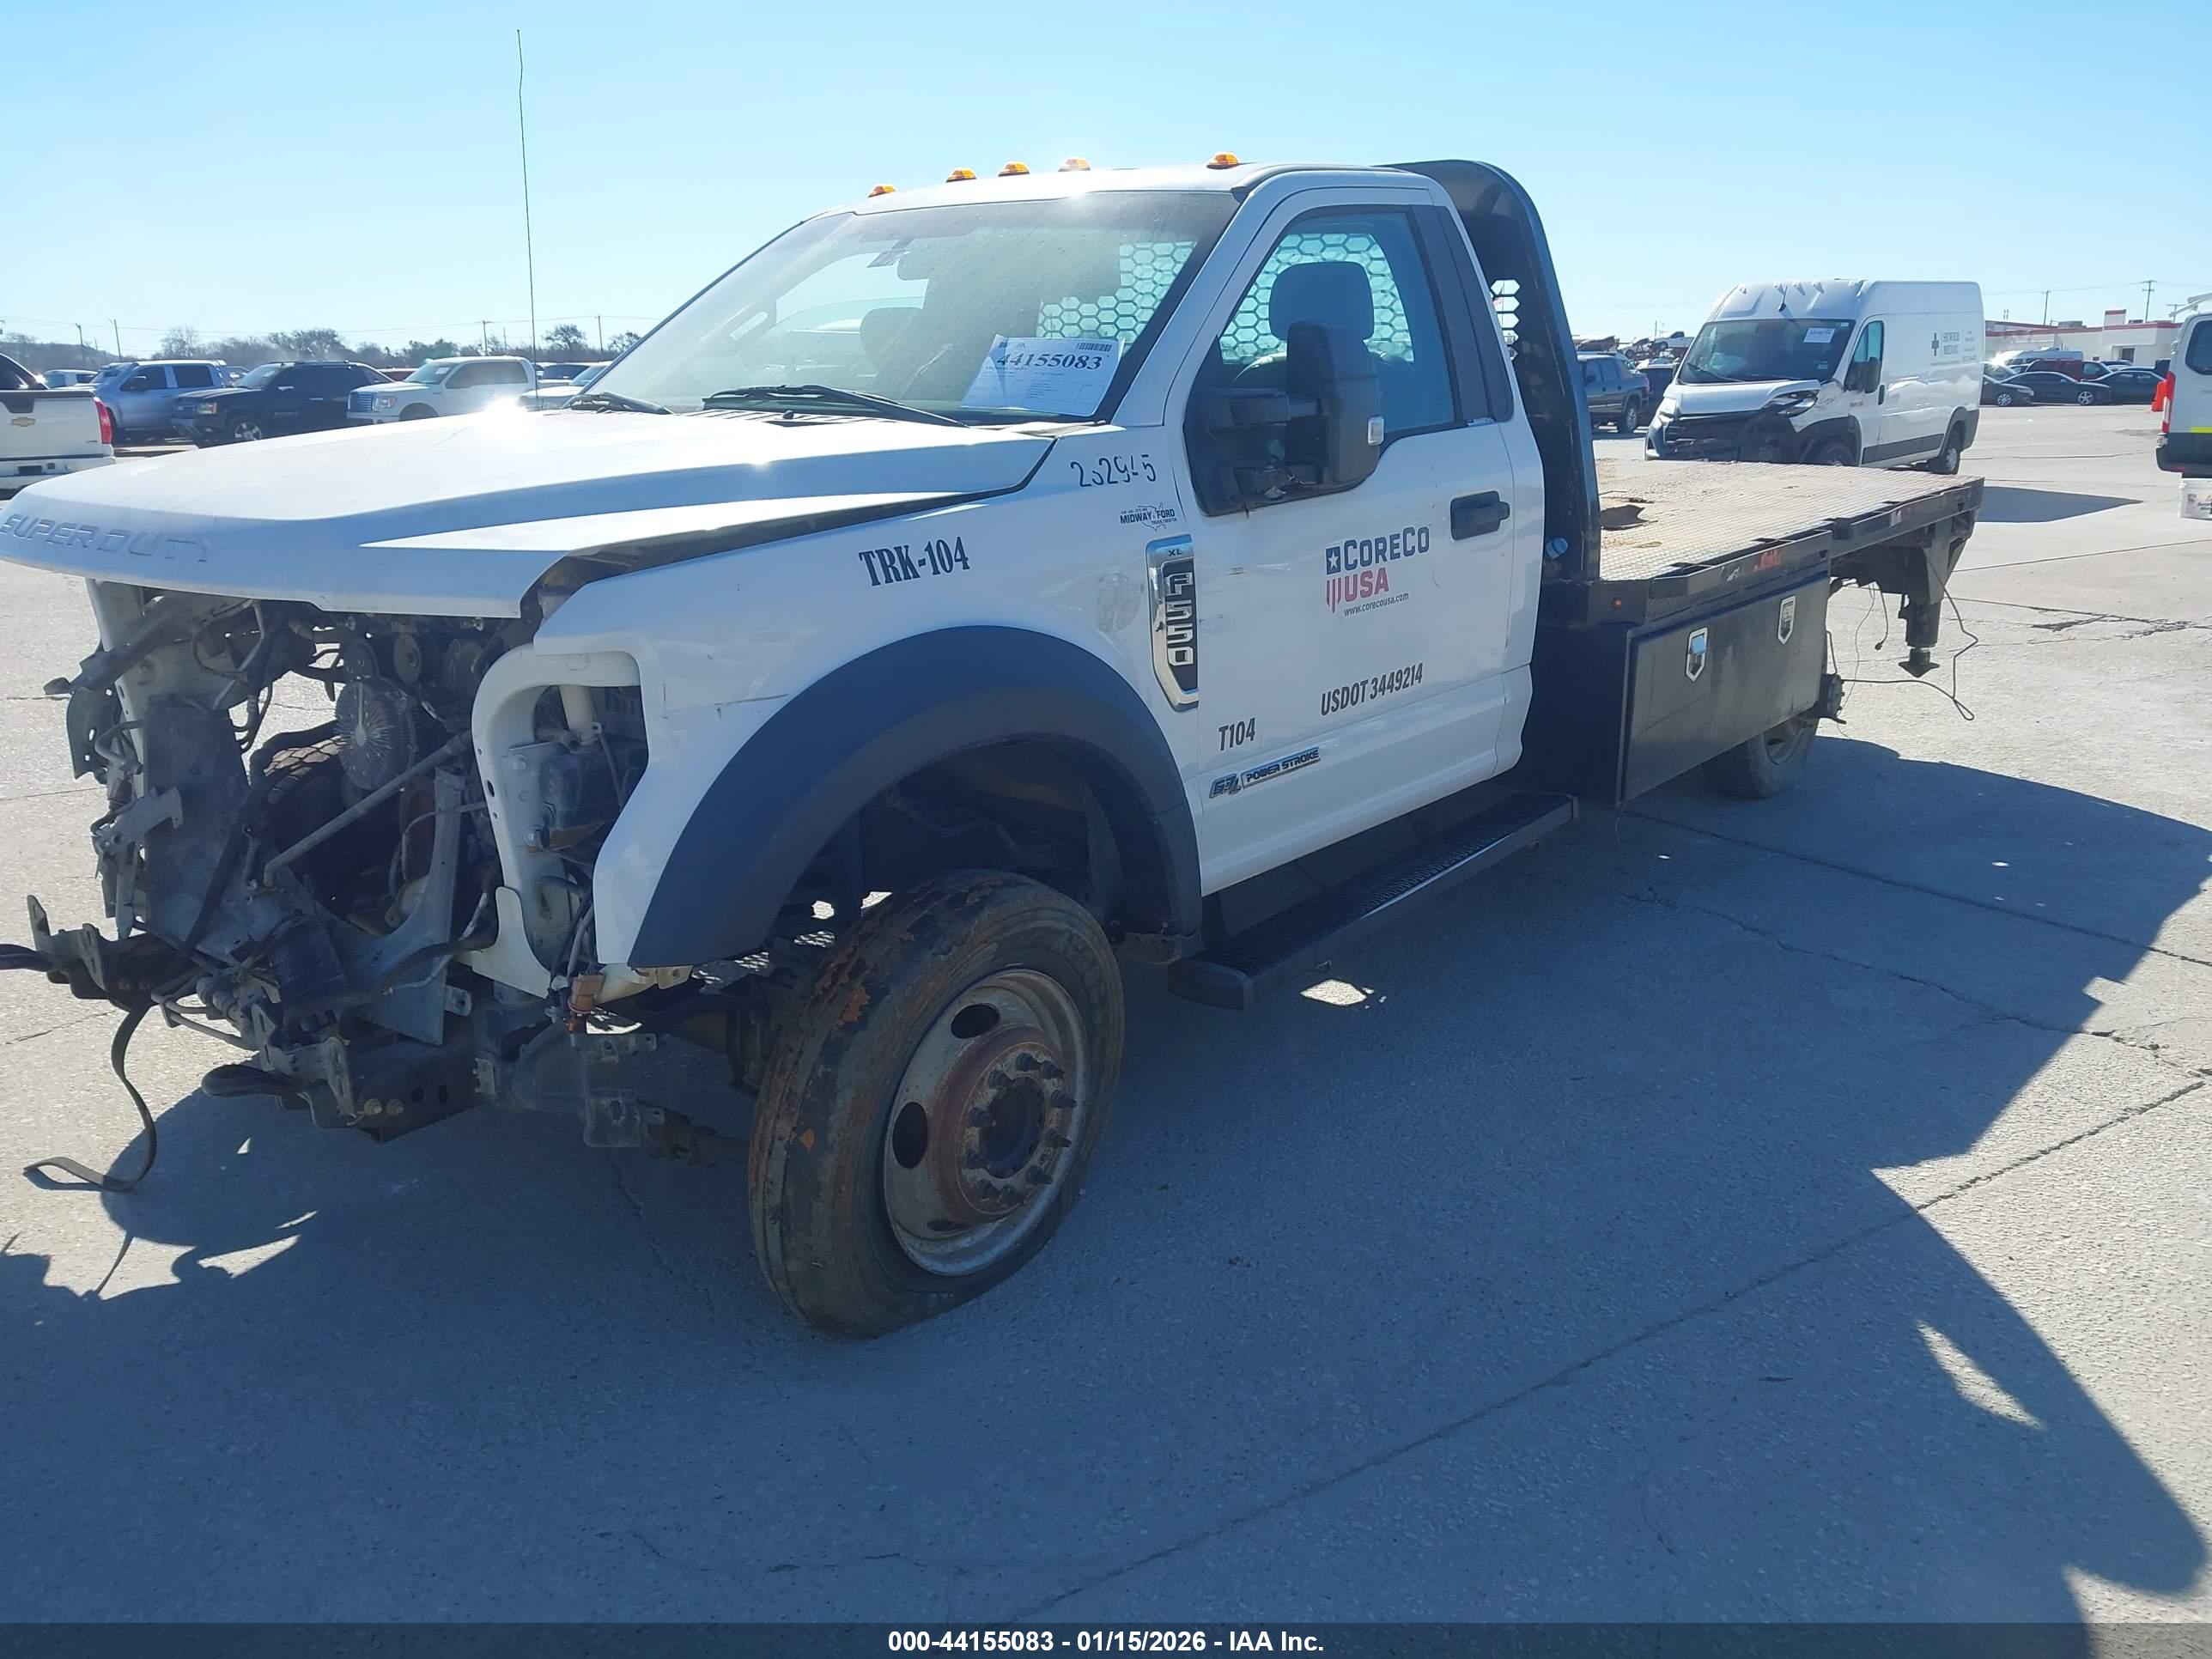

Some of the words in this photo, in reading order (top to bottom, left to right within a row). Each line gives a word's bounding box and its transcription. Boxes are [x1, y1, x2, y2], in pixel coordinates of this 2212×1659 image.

[997, 353, 1103, 370] 44155083
[1120, 511, 1152, 525] MIDWAY
[1157, 508, 1176, 520] FORD
[0, 514, 98, 549] SUPER
[96, 528, 208, 562] DUTY
[859, 537, 970, 586] TRK-104
[1344, 568, 1389, 602] USA
[1165, 572, 1194, 666] F550
[1344, 592, 1409, 616] www.corecousa.com
[1321, 679, 1369, 715] USDOT
[1370, 662, 1423, 700] 3449214
[1218, 717, 1255, 751] T104
[1245, 764, 1281, 782] POWER
[1281, 749, 1320, 770] STROKE
